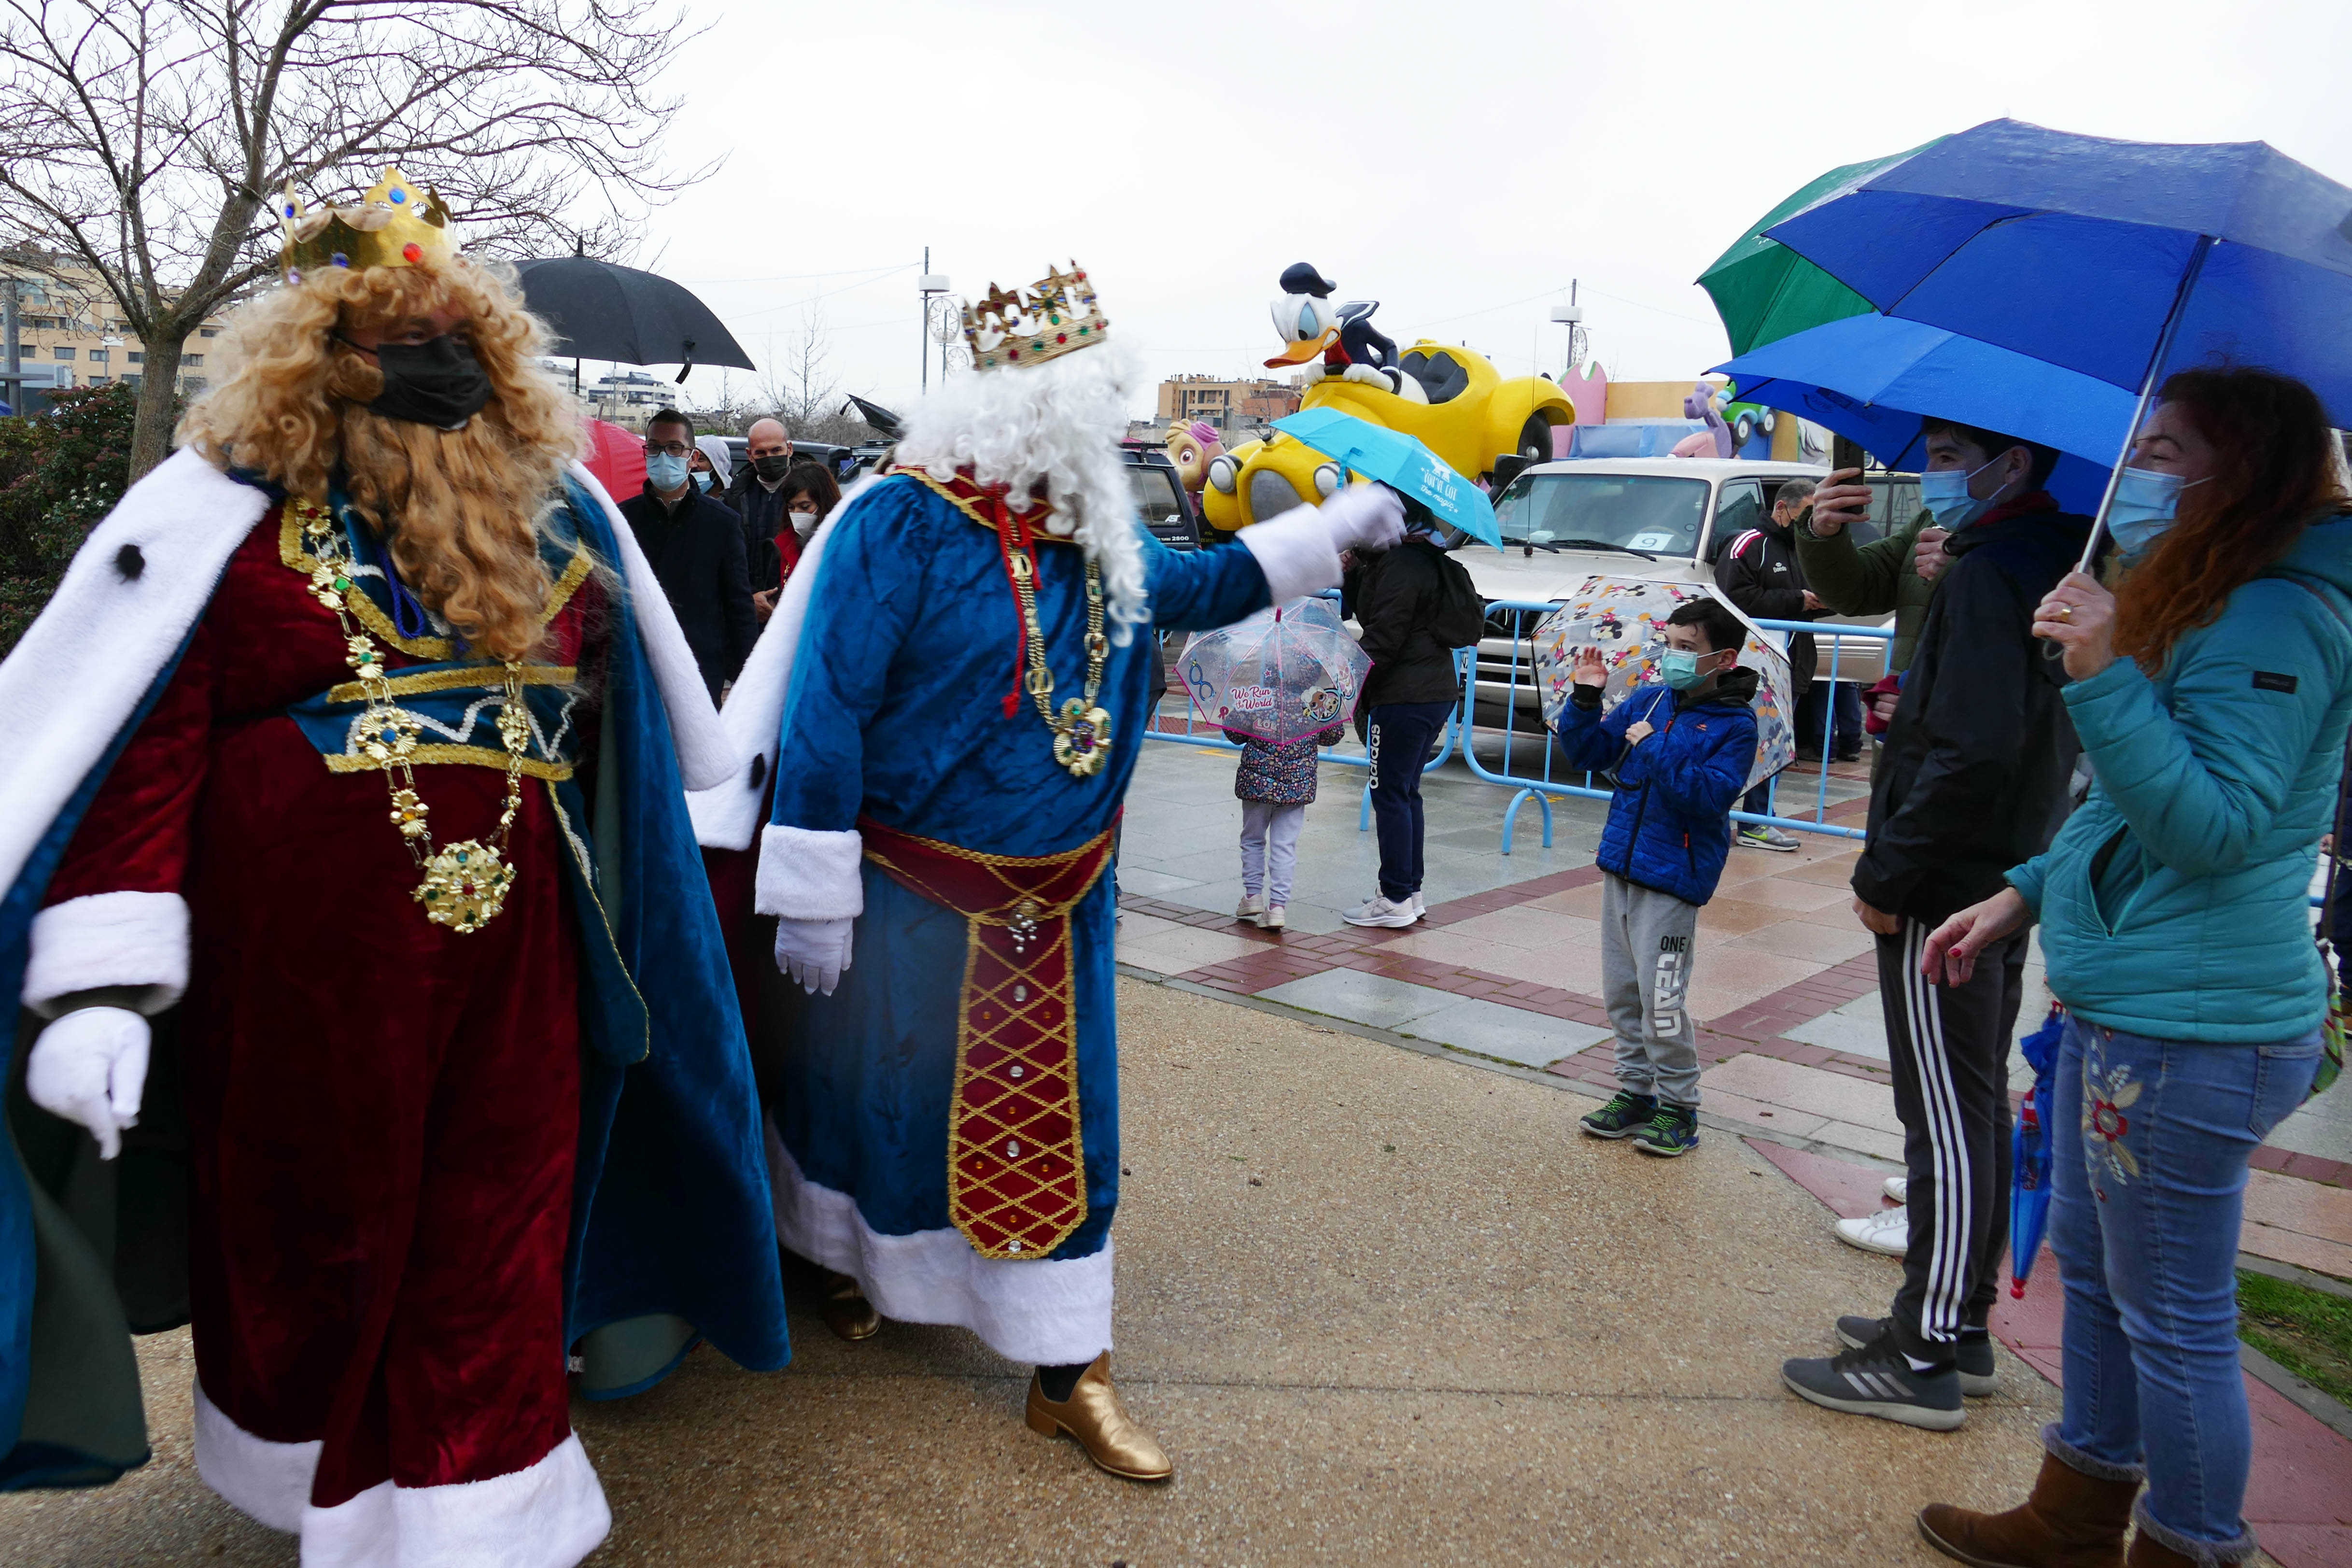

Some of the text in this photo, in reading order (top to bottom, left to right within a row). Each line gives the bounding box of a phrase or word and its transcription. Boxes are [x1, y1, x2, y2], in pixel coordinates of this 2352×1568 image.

[1421, 484, 1454, 509] the magic
[1639, 538, 1657, 548] 9
[1232, 686, 1271, 699] We Run
[1243, 697, 1272, 709] World
[1370, 724, 1380, 789] adidas
[1660, 935, 1686, 952] ONE
[1654, 953, 1683, 1038] TEAM
